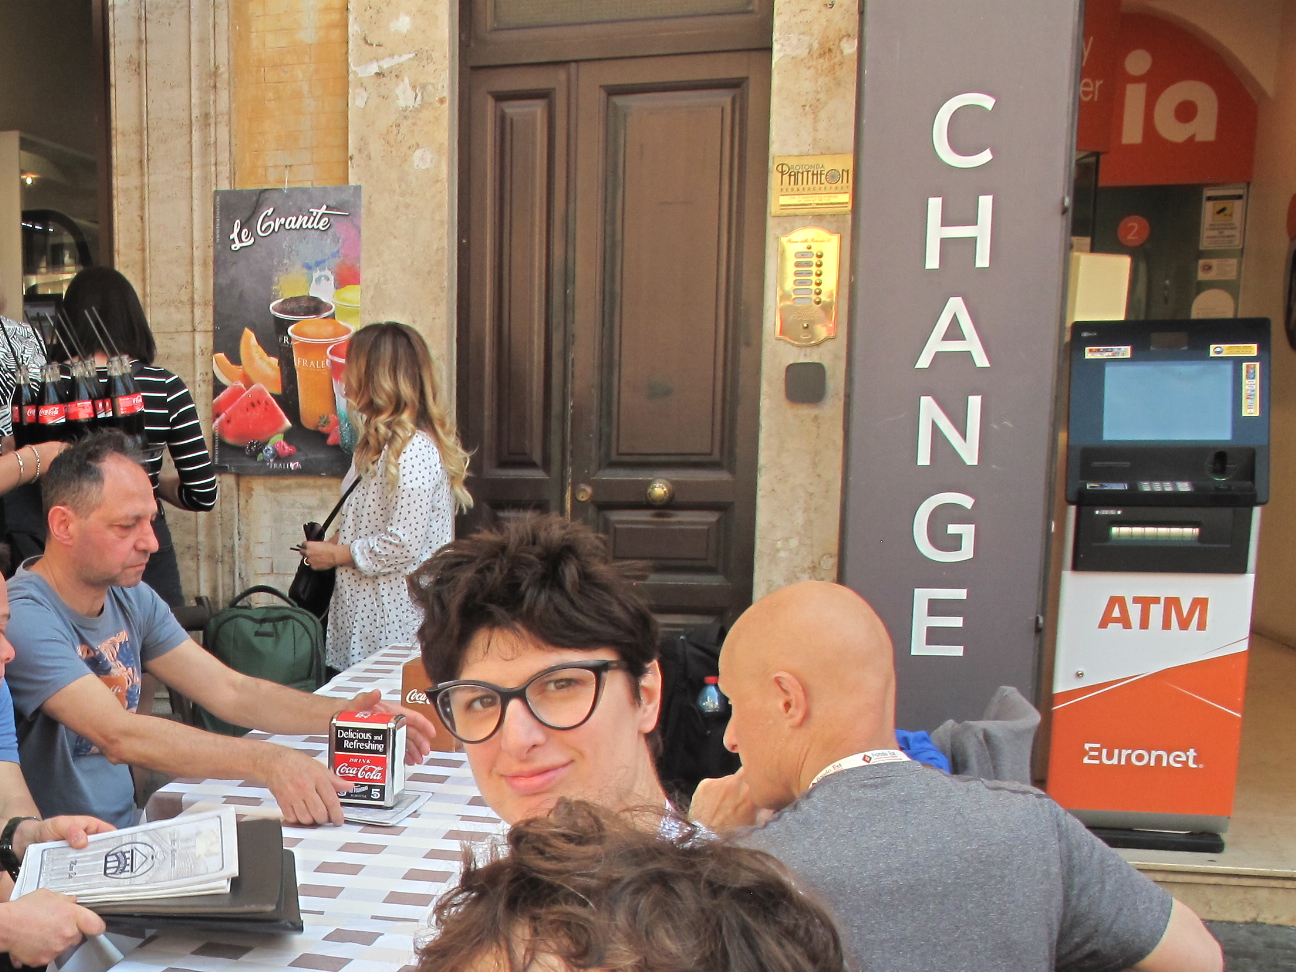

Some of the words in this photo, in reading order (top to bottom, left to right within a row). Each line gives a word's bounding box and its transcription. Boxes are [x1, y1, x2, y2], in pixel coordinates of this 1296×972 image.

[1121, 49, 1218, 144] ia
[776, 163, 850, 186] PANTHEON
[790, 163, 825, 171] ROTONDA
[229, 219, 255, 251] Le
[256, 204, 349, 237] Granite
[1126, 222, 1139, 239] 2
[911, 92, 997, 657] CHANGE
[1097, 595, 1210, 632] ATM
[406, 688, 431, 705] Coca
[337, 729, 372, 740] Delicious
[343, 740, 384, 752] Refreshing
[1083, 743, 1198, 768] Euronet
[336, 763, 384, 780] Coca-Cola
[370, 788, 381, 799] 5
